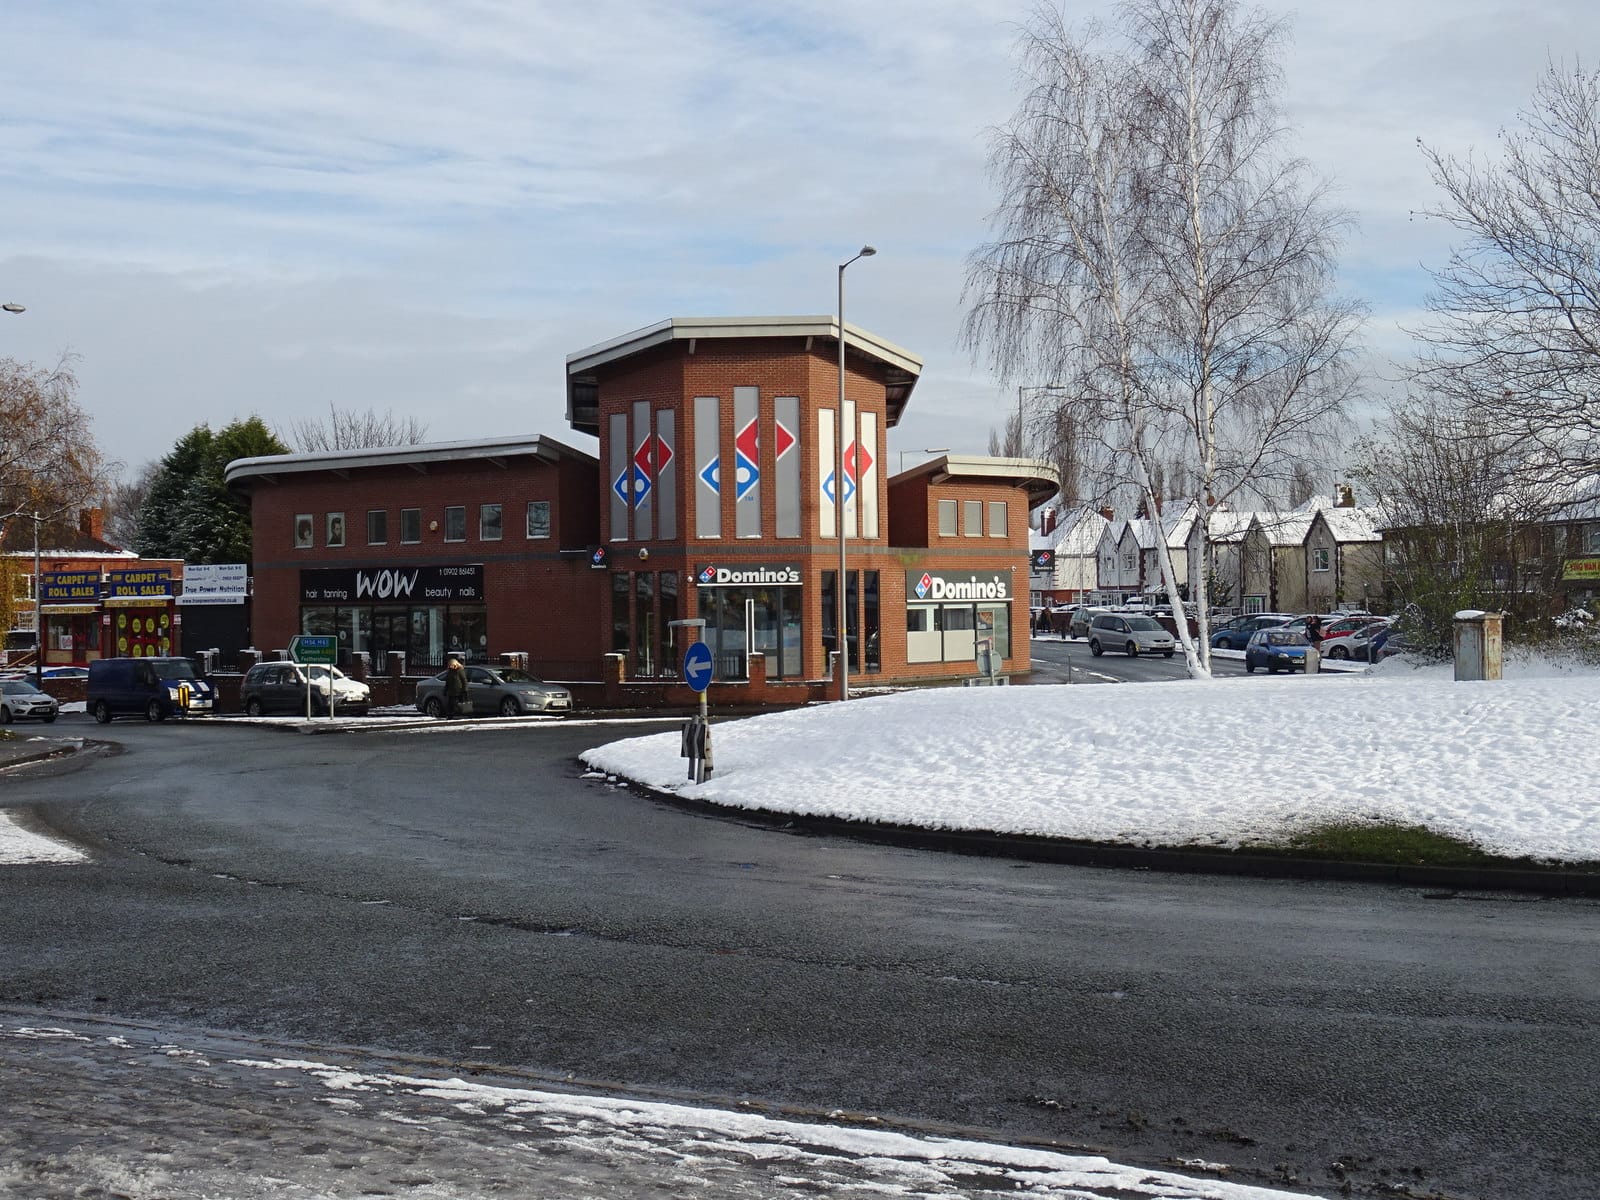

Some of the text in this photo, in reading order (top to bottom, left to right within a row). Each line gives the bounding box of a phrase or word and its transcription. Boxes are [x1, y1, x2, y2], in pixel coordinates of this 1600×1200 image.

[57, 575, 86, 585] CARPET
[125, 573, 156, 583] CARPET
[716, 566, 800, 583] Domino's
[219, 585, 245, 593] Nutrition
[356, 569, 419, 599] WOW
[931, 575, 1007, 599] Domino's
[48, 586, 95, 597] ROLL SALES
[116, 585, 166, 596] ROLL SALES
[305, 588, 348, 600] hair tanning
[425, 586, 476, 599] beauty nails
